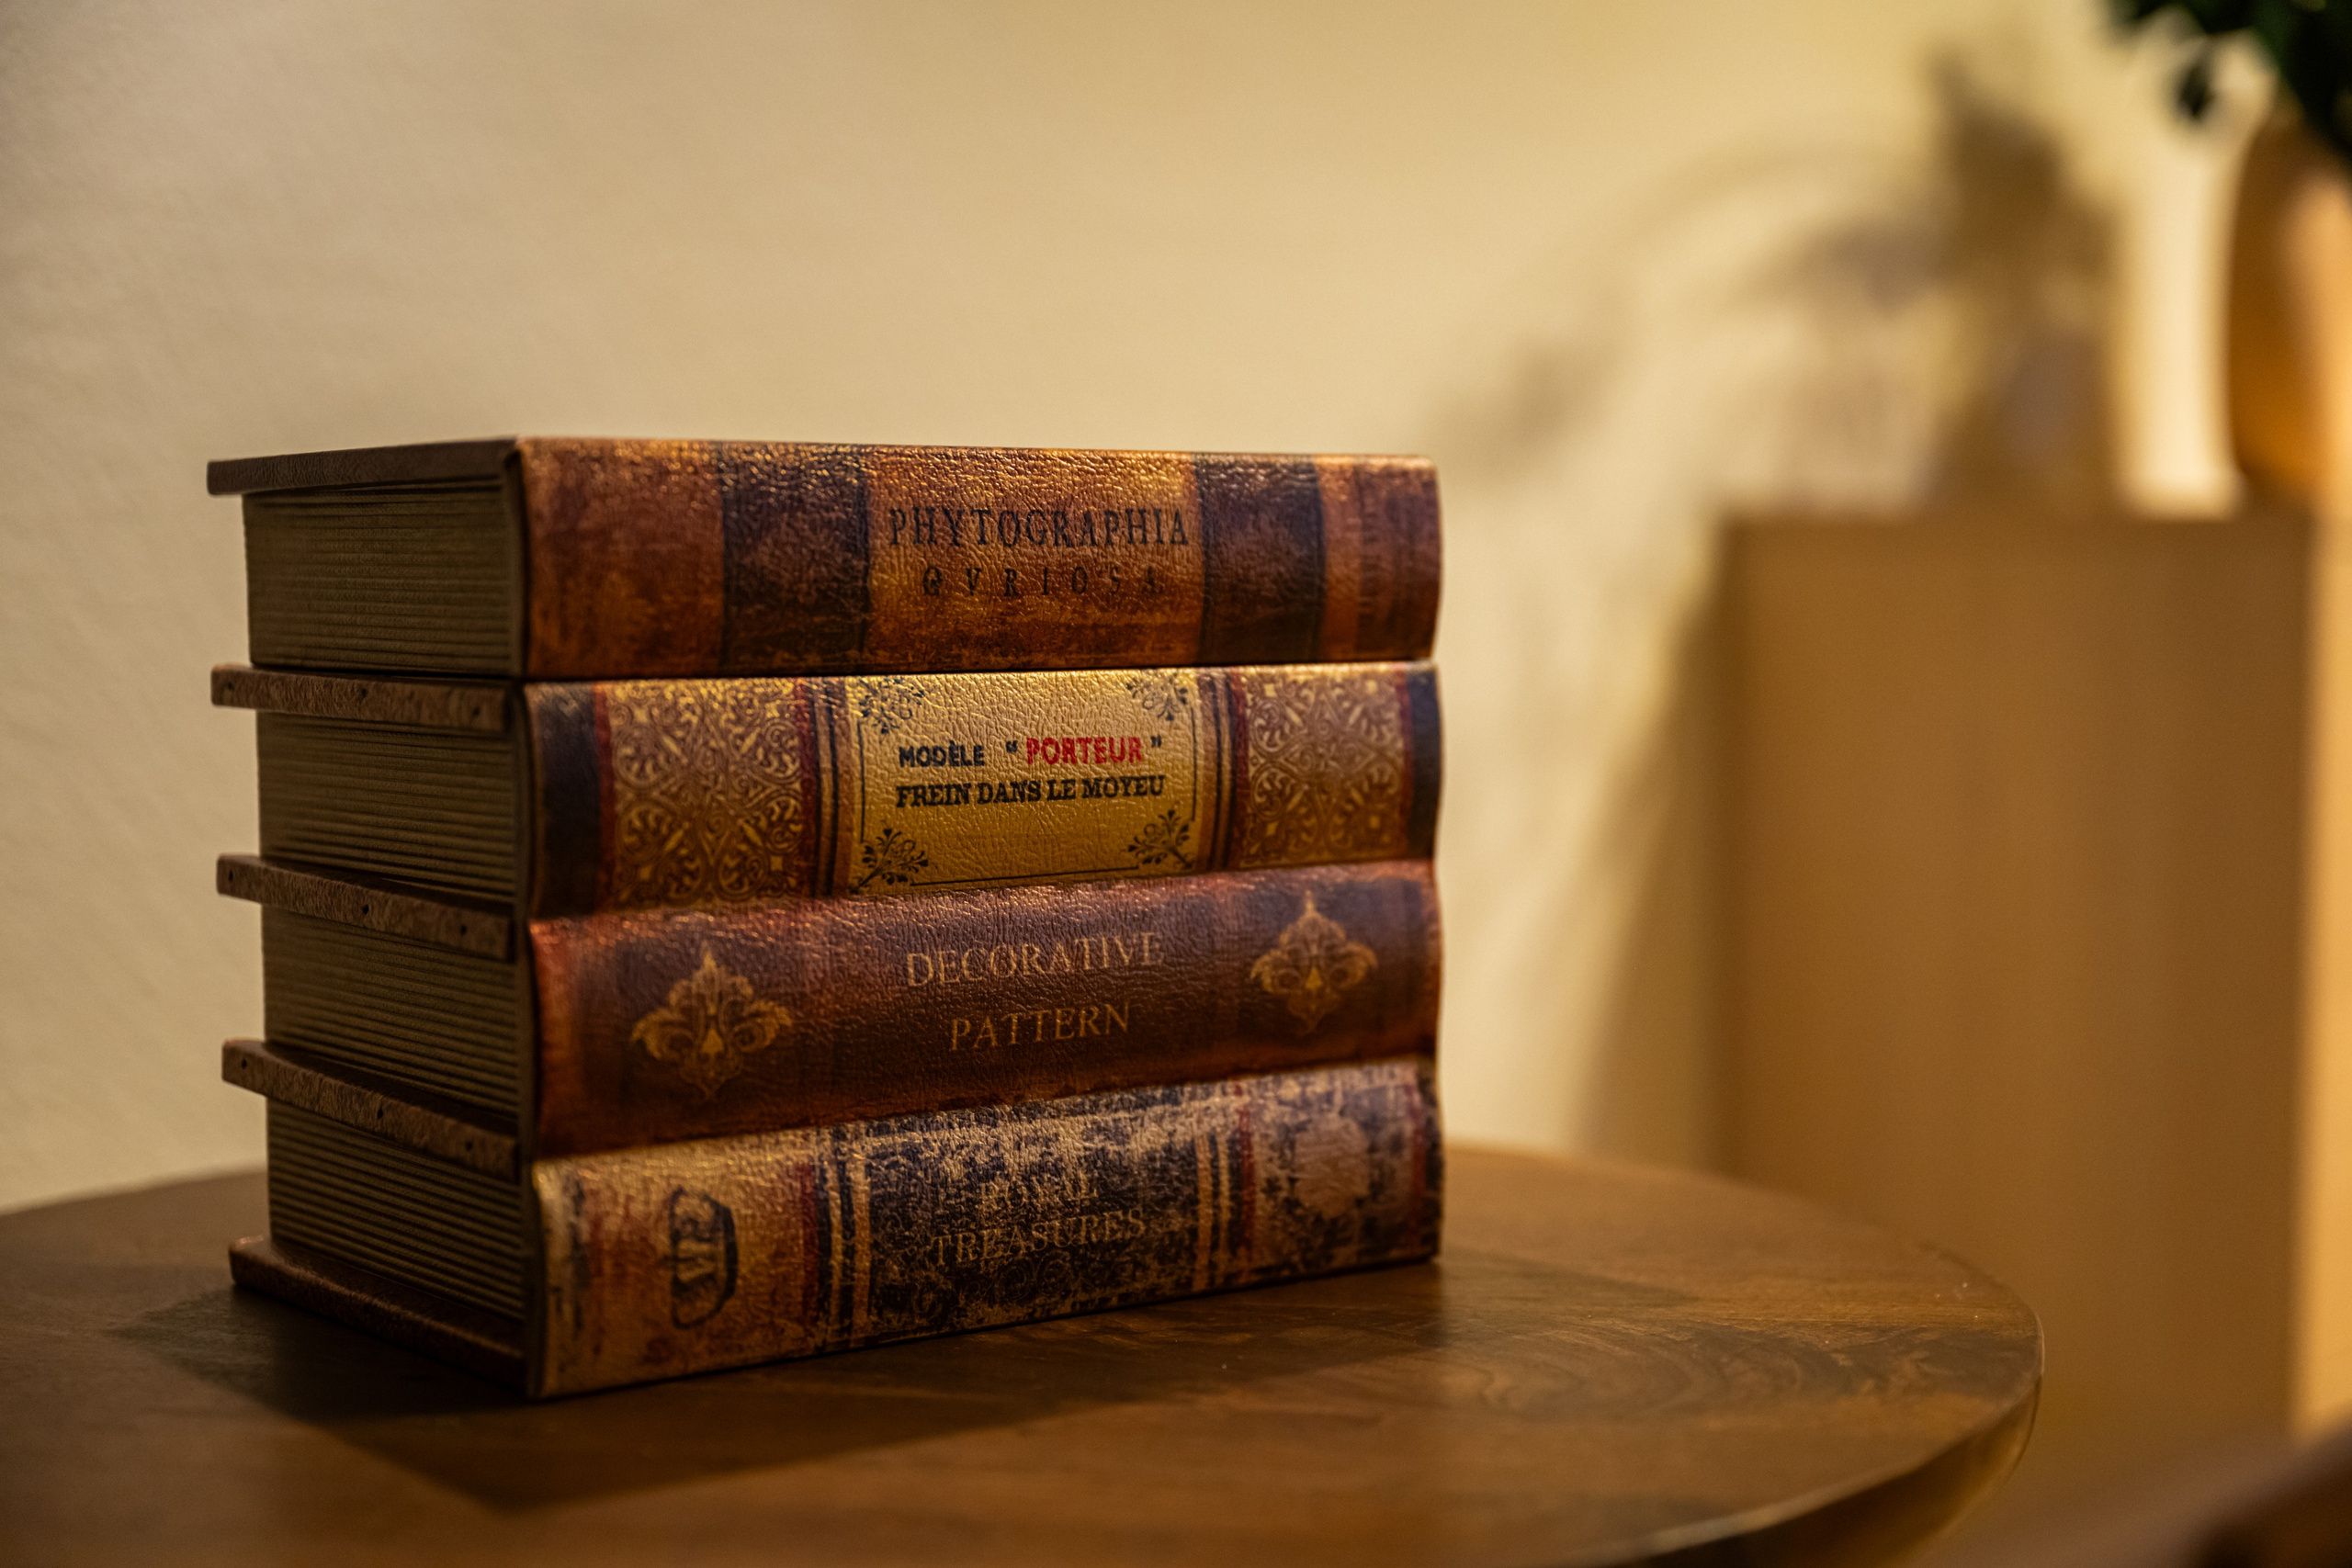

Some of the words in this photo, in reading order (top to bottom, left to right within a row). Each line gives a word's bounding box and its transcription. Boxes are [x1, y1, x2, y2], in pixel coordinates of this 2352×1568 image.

[888, 507, 1190, 548] PHYTOGRAPHIA
[899, 739, 986, 768] MODÈLE
[895, 782, 971, 808] FREIN
[976, 779, 1042, 805] DANS
[1046, 777, 1077, 802] LE
[1081, 774, 1167, 800] MOYEU
[906, 931, 1164, 987] DECORATIVE
[948, 1002, 1131, 1052] PATTERN
[930, 1205, 1147, 1267] TREASURES
